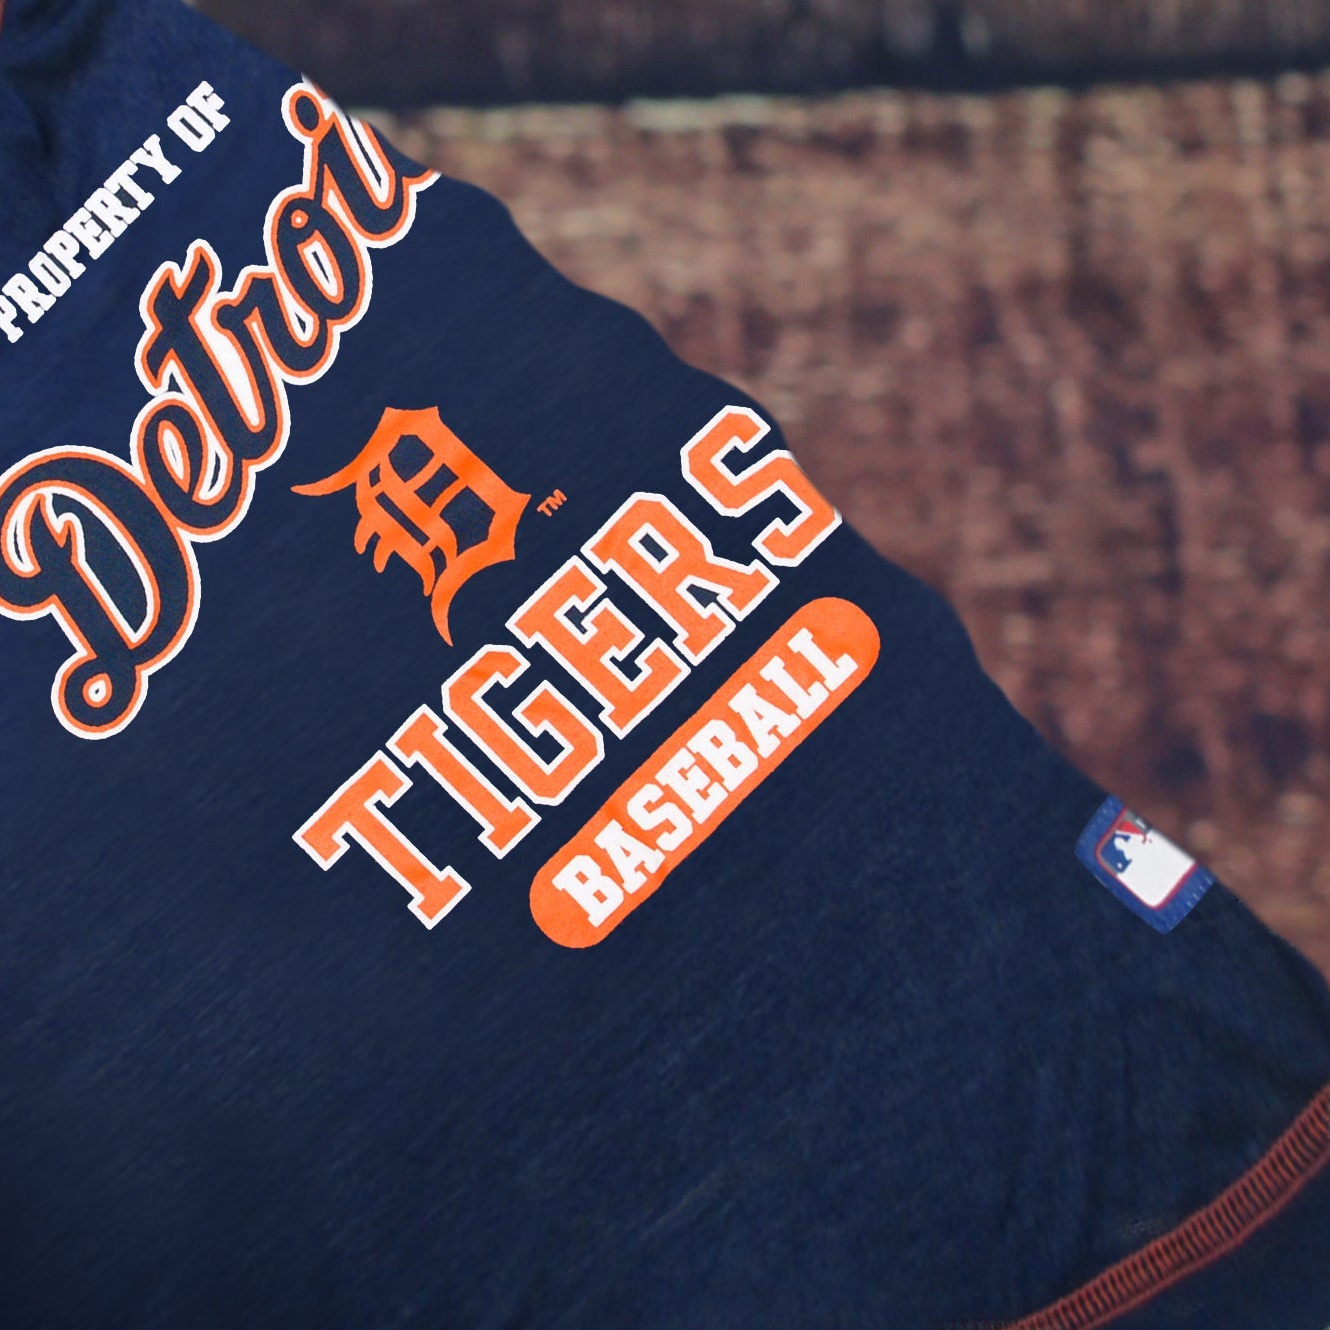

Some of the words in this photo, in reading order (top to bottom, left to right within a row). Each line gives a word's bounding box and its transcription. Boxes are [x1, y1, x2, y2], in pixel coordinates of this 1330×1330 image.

[167, 80, 231, 152] OF
[292, 405, 843, 930] TIGERS
[551, 627, 859, 929] BASEBALL
